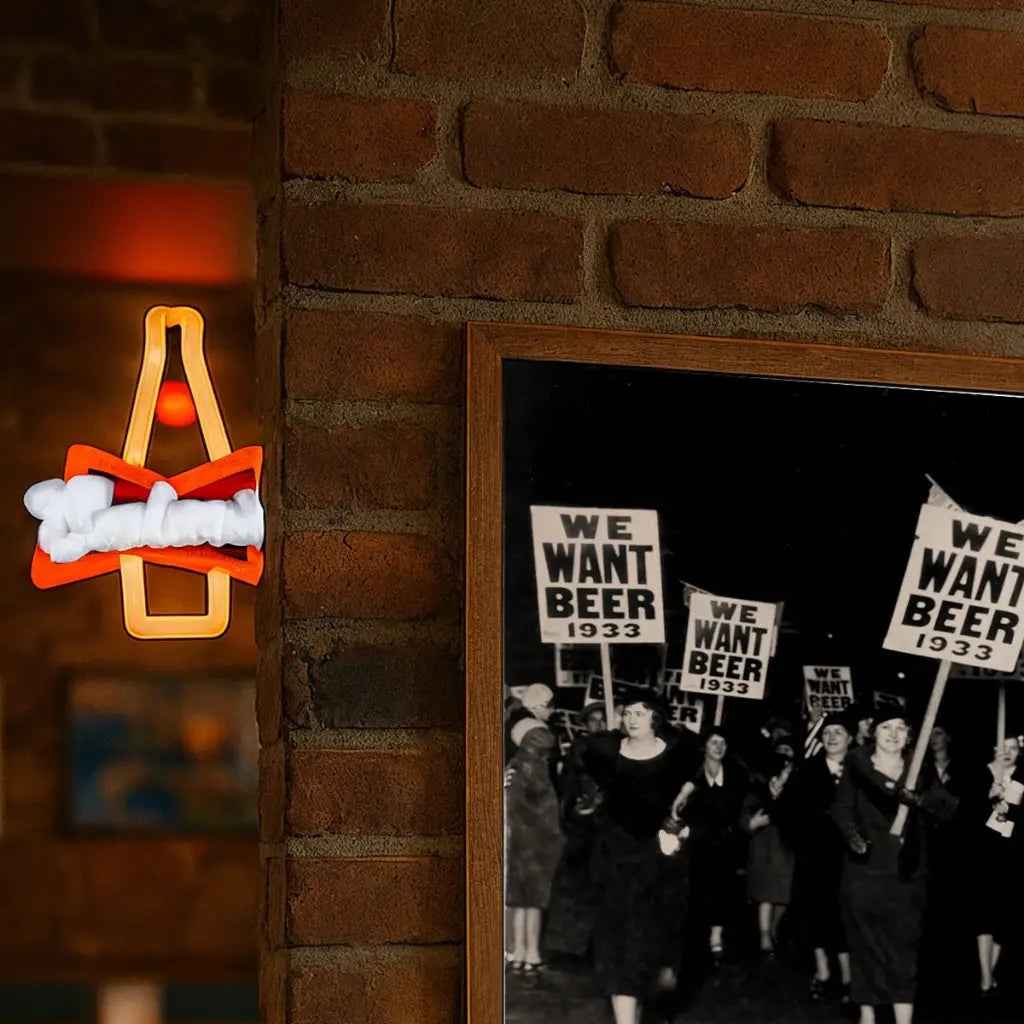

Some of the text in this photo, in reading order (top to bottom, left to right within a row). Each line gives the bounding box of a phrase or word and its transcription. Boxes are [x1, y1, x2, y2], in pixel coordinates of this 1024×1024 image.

[560, 514, 632, 540] WE
[952, 519, 1024, 560] WE
[542, 542, 653, 585] WANT
[545, 586, 656, 620] BEER
[710, 600, 758, 624] WE
[568, 622, 641, 638] 1933
[901, 593, 1020, 645] BEER
[695, 618, 768, 657] WANT
[916, 633, 993, 661] 1933
[688, 650, 763, 682] BEER
[814, 668, 841, 678] WE
[700, 678, 749, 695] 1933
[808, 679, 849, 695] WANT
